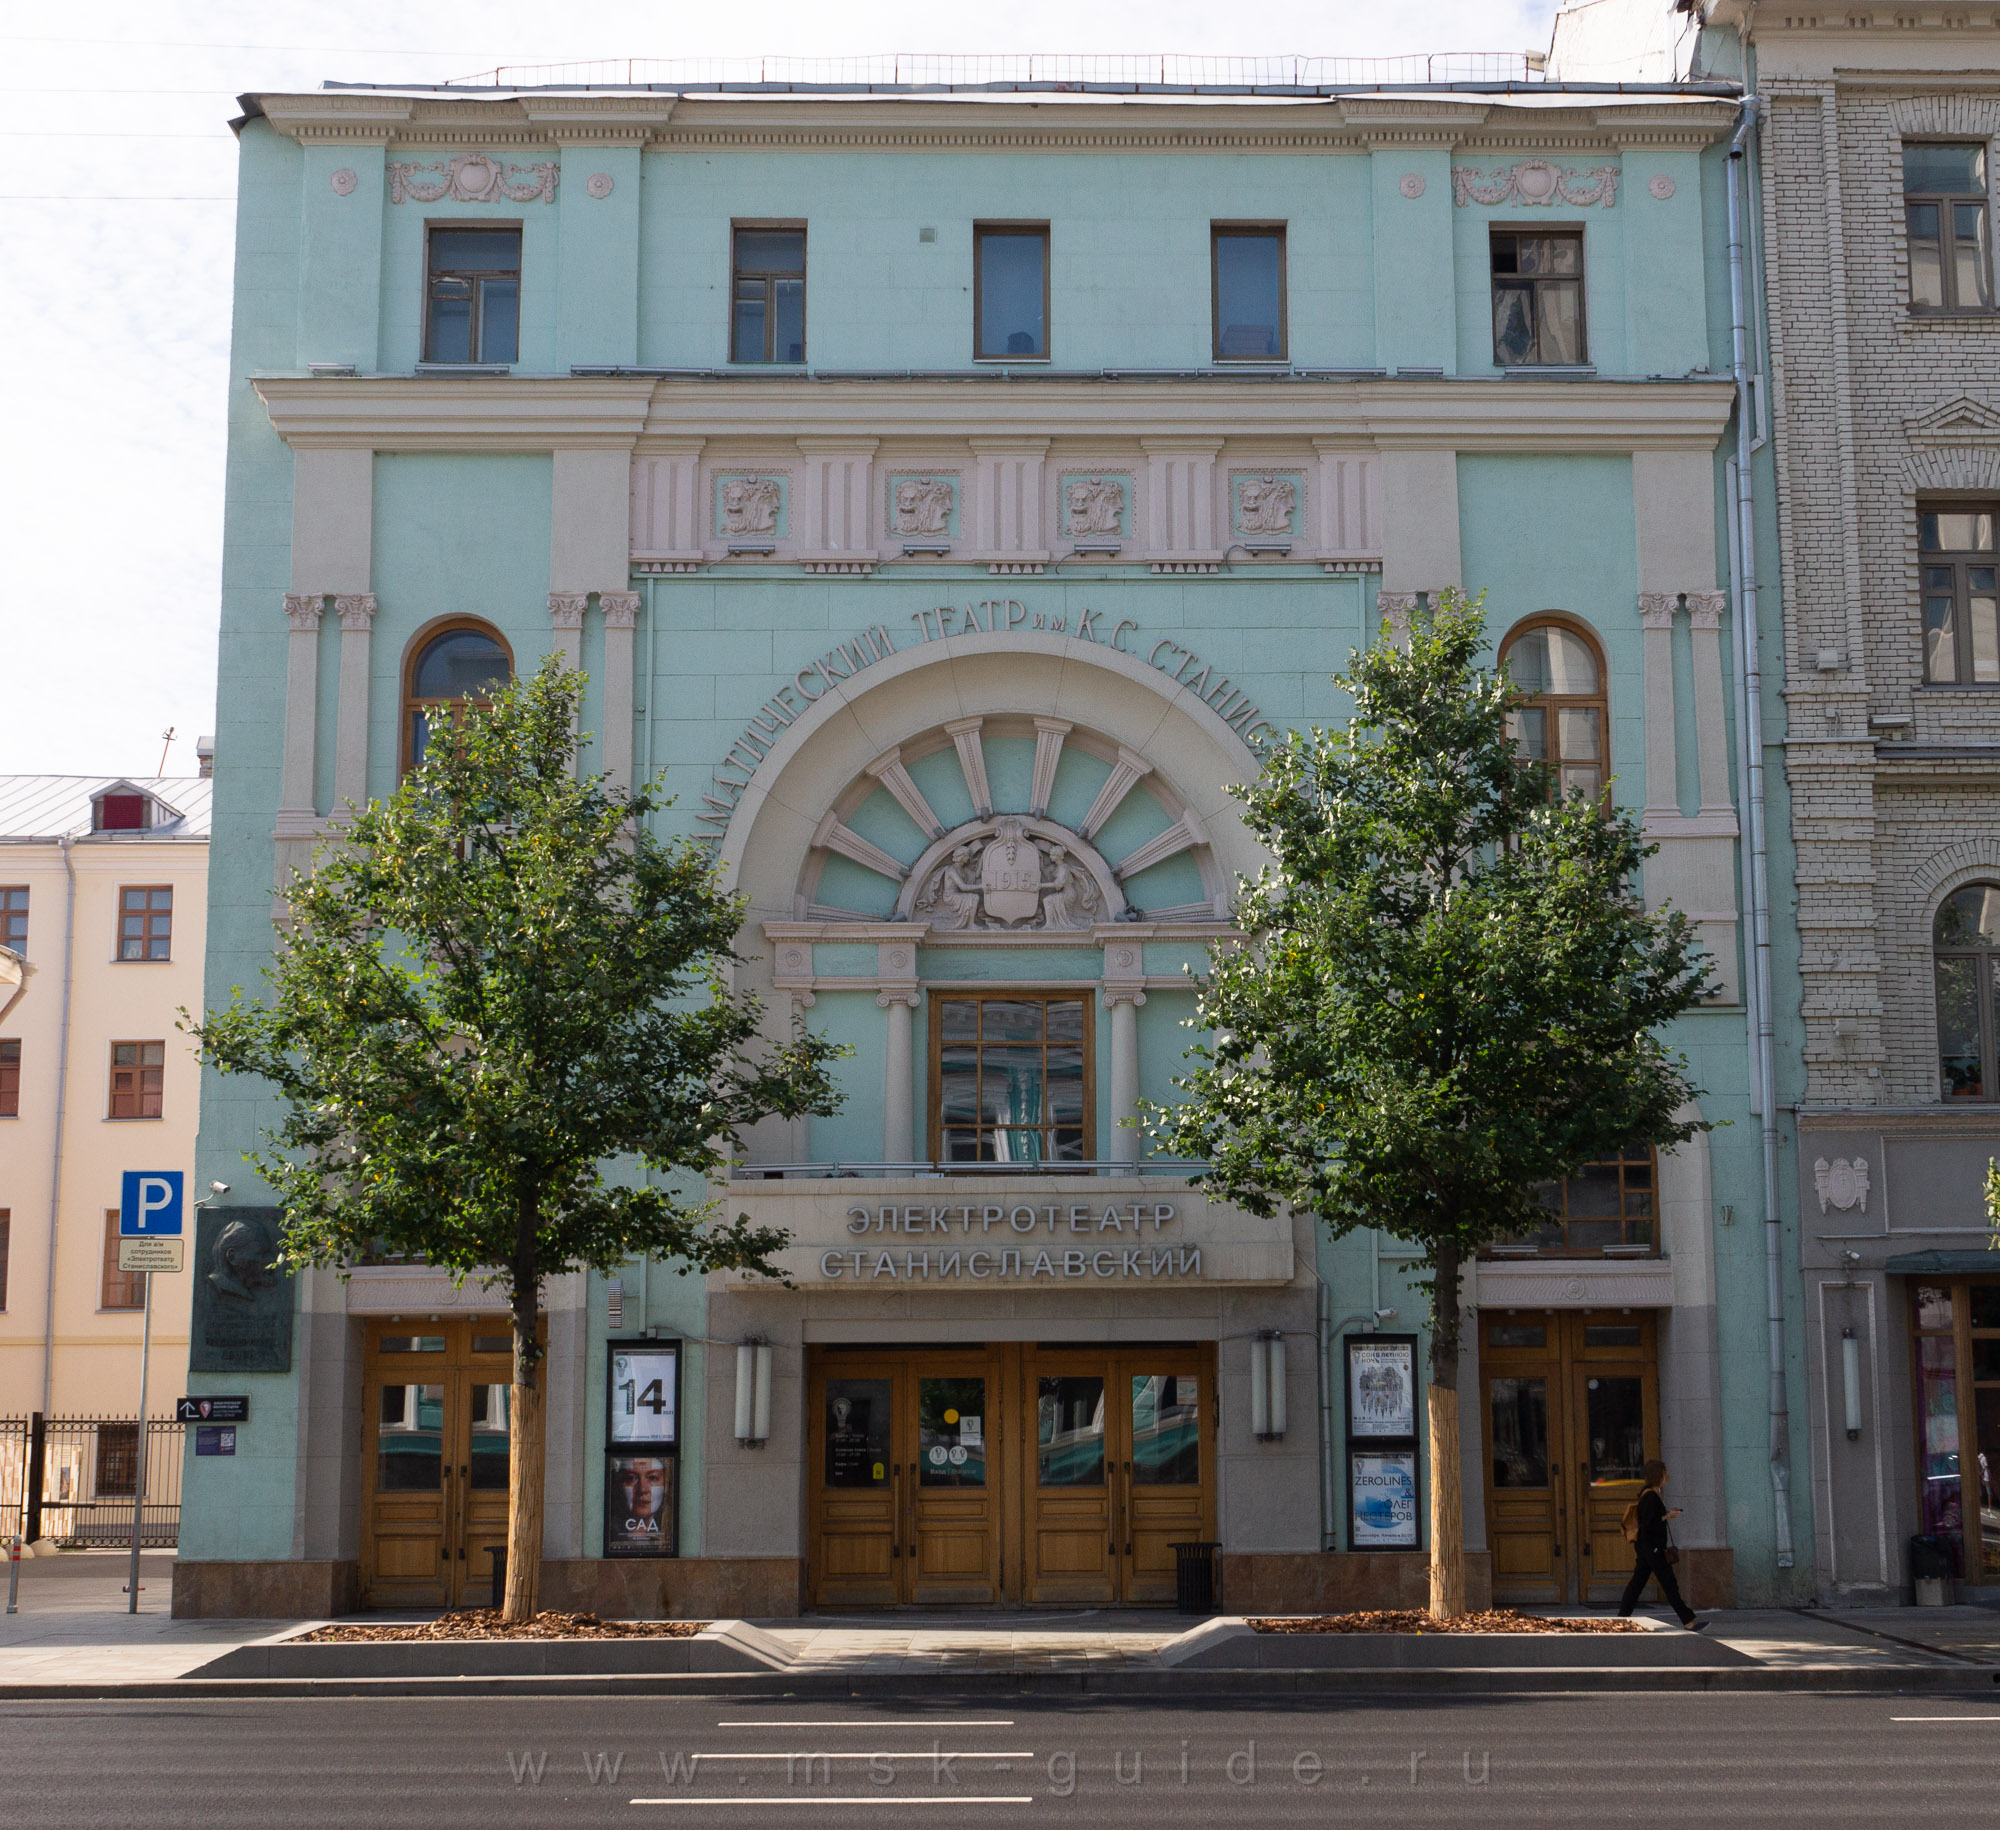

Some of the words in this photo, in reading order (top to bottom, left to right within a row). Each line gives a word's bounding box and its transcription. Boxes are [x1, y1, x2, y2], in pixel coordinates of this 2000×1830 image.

[688, 624, 898, 860] АМАТИЧЕСКИЙ
[911, 599, 1026, 643] ТЕАТР
[138, 1177, 173, 1228] P
[847, 1203, 1176, 1234] ЭЛЕКТРОТЕАТР
[820, 1243, 1201, 1279] СТАНИСЛАВСКИЙ
[618, 1379, 666, 1415] 14
[1355, 1476, 1412, 1485] ZEROLINES
[1404, 1488, 1412, 1497] &
[1384, 1500, 1412, 1508] ОЛЕГ
[625, 1518, 659, 1532] САД
[1355, 1512, 1412, 1520] НЕСТЕРОВ
